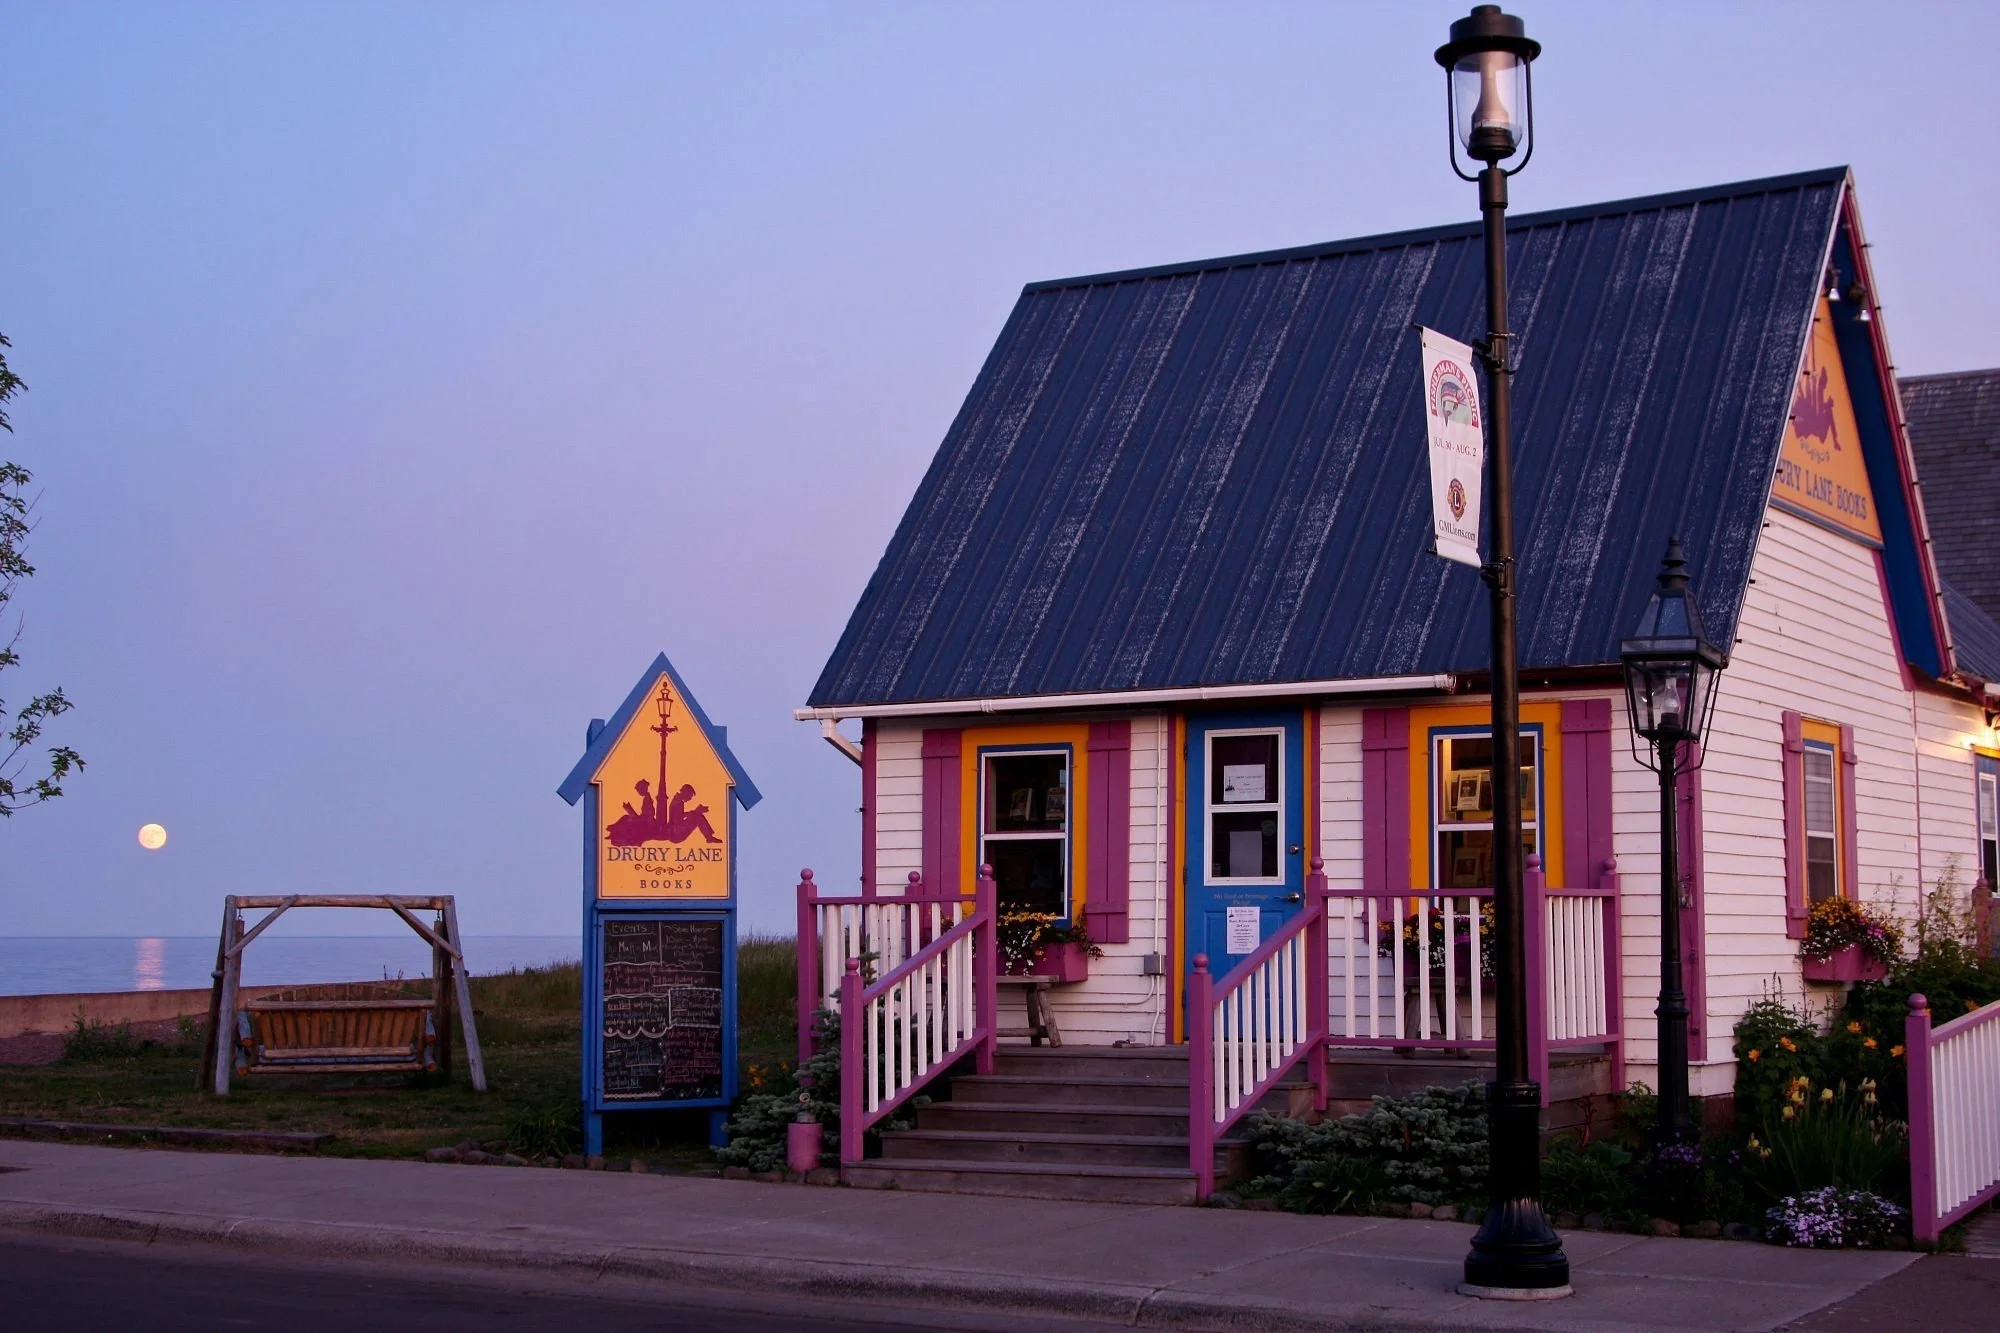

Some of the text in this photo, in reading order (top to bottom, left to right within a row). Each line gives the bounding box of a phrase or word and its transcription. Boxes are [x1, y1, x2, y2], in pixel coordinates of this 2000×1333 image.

[1430, 361, 1478, 422] FISHERMAN'S PICNIC
[1455, 443, 1471, 456] AUG.
[1472, 447, 1477, 457] 2
[1805, 469, 1833, 506] LANE
[1836, 484, 1867, 520] BOOKS
[607, 846, 723, 862] DRURY LANE
[639, 879, 692, 889] BOOKS
[611, 922, 648, 934] Events
